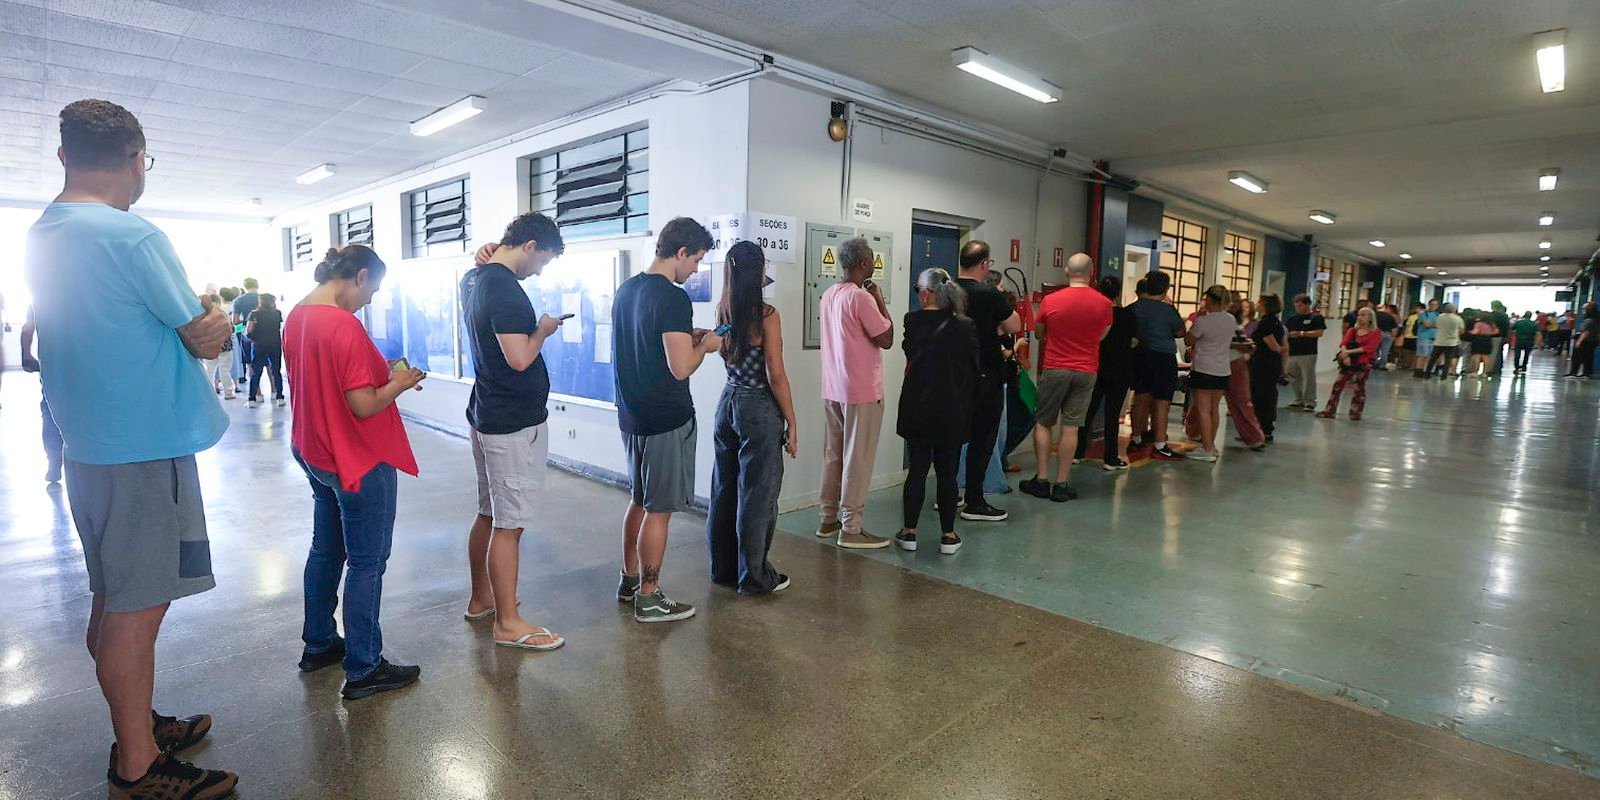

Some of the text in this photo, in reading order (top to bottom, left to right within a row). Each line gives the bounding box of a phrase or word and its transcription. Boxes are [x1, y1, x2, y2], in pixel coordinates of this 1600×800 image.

[712, 219, 740, 230] SEES
[759, 219, 788, 229] SEÇÕES
[757, 237, 789, 250] 30 a 36
